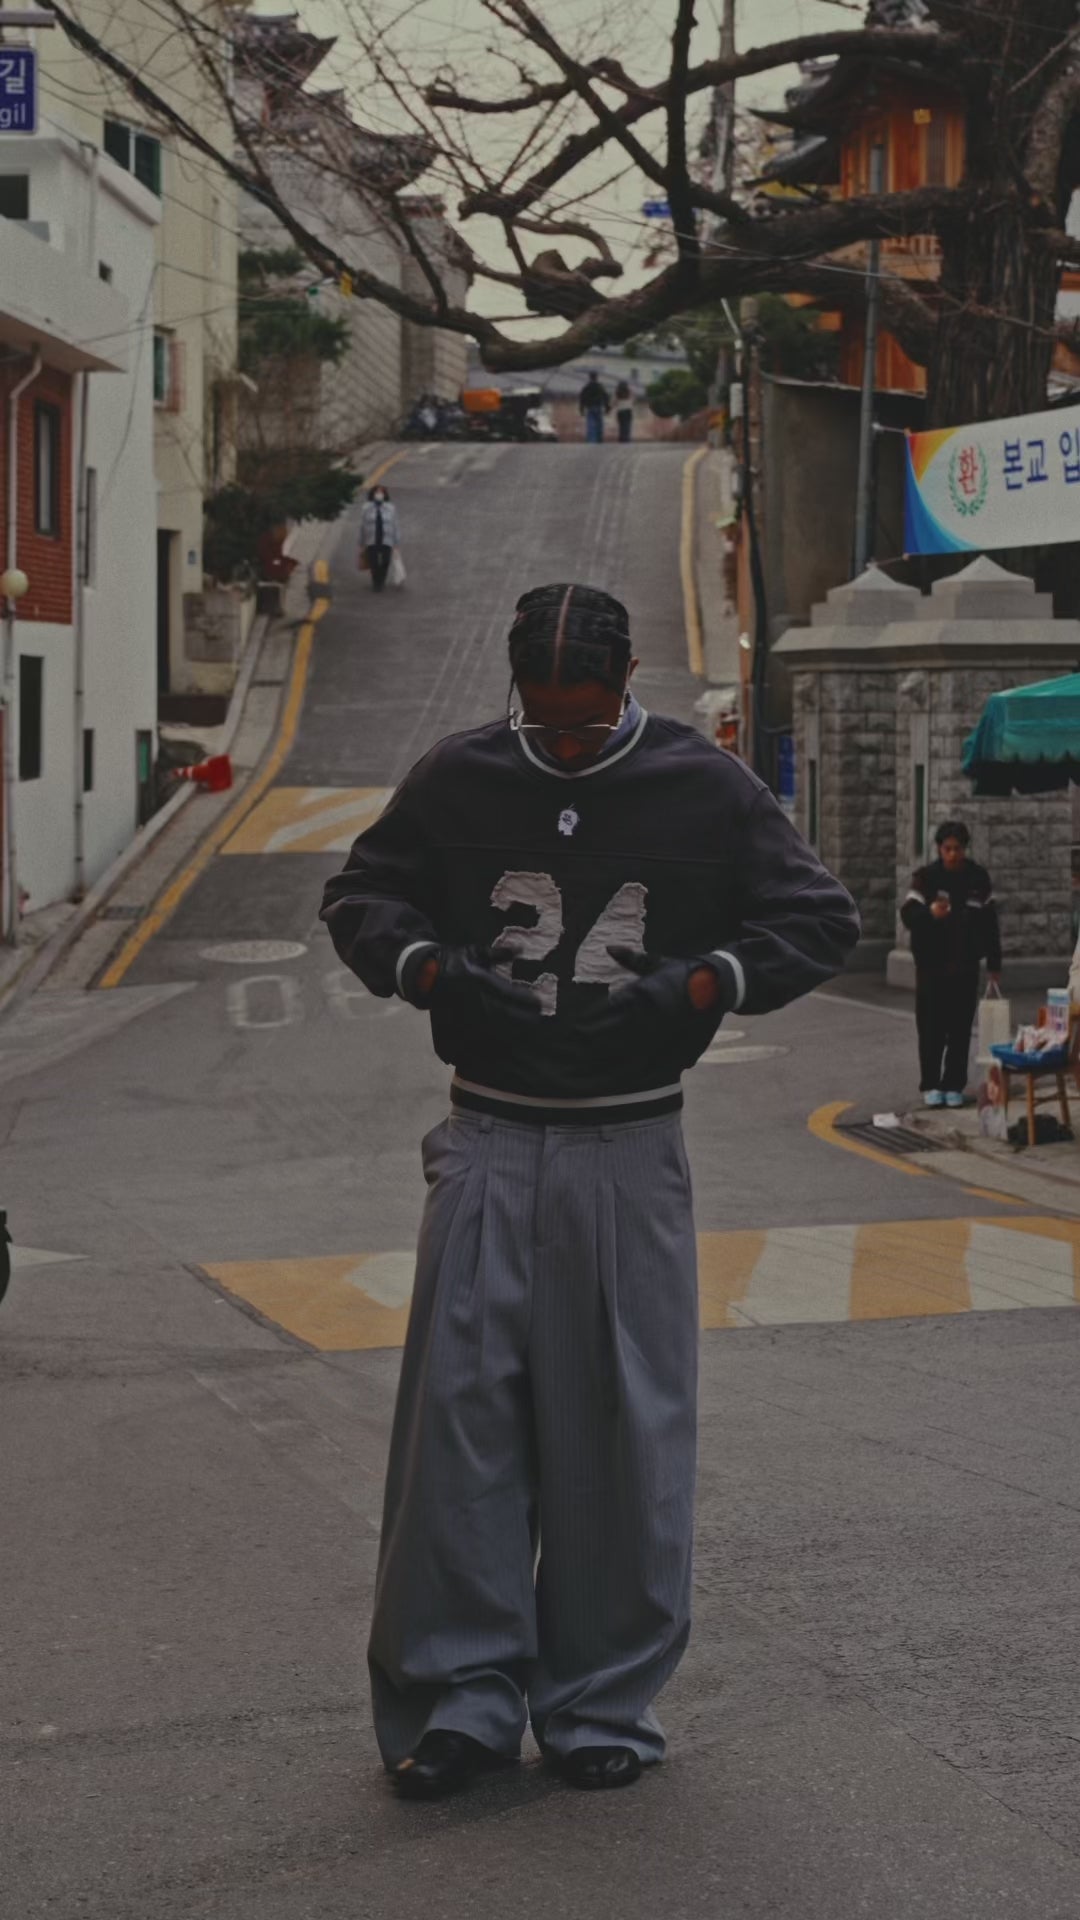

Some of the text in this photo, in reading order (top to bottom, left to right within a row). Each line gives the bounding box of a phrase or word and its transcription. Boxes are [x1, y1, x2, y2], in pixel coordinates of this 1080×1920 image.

[0, 103, 26, 128] gil
[1002, 437, 1048, 491] 본교
[490, 870, 649, 1016] 24
